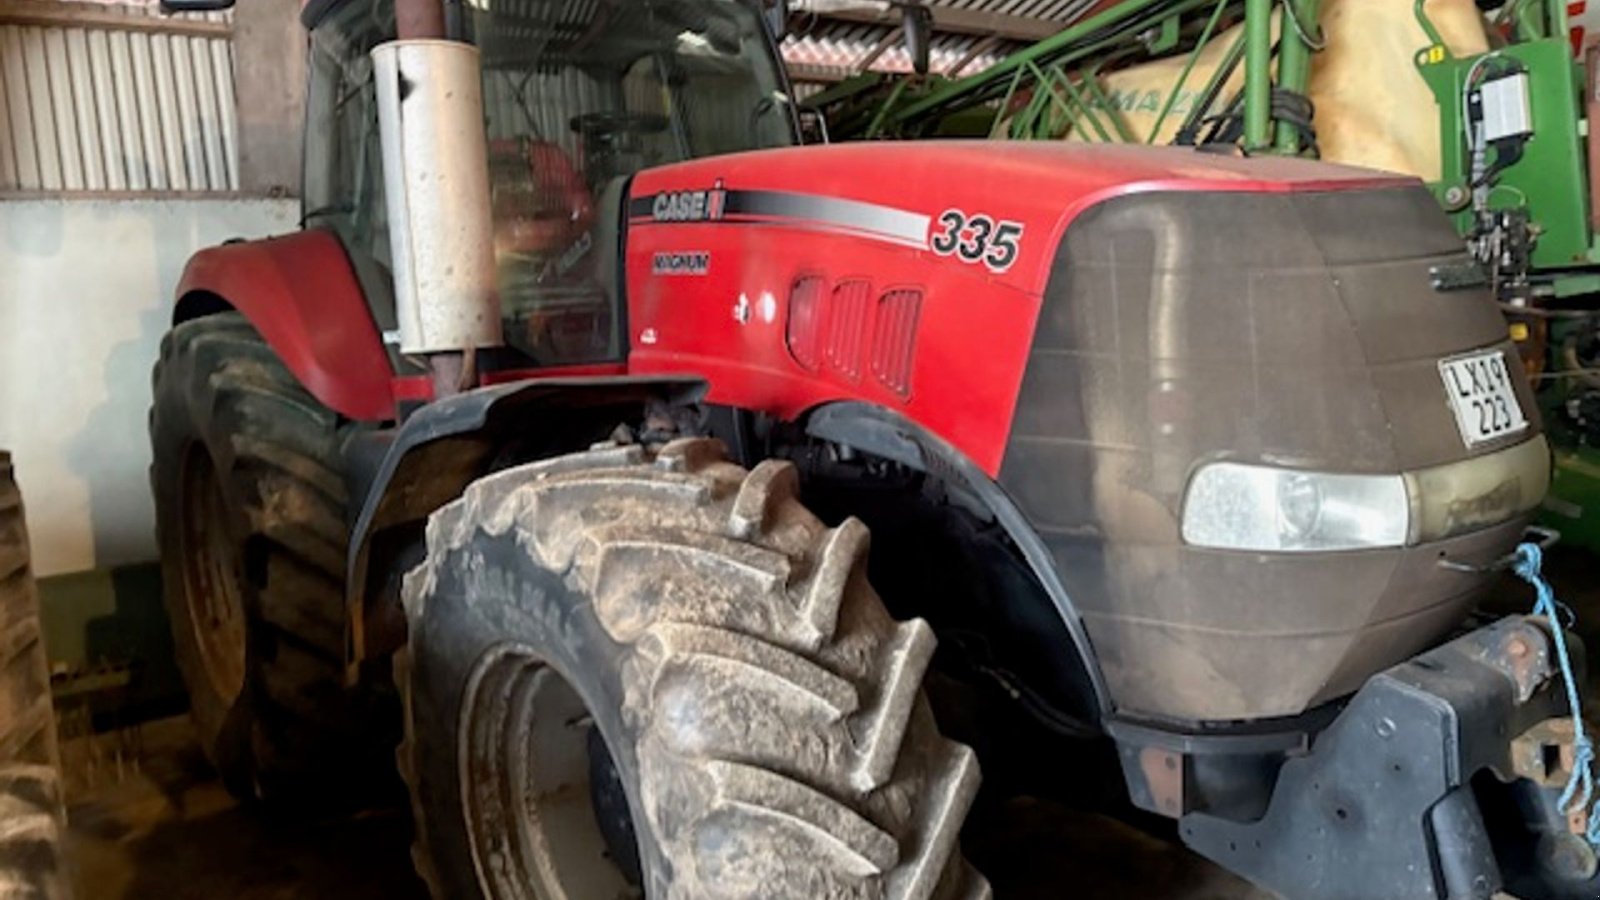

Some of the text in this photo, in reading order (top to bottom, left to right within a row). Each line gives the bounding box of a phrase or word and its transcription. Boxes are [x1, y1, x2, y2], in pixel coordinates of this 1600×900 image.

[652, 190, 706, 221] CASE
[932, 210, 1022, 271] 335
[654, 253, 709, 272] MAGNUM
[1448, 357, 1505, 397] LX19
[1472, 395, 1512, 435] 223
